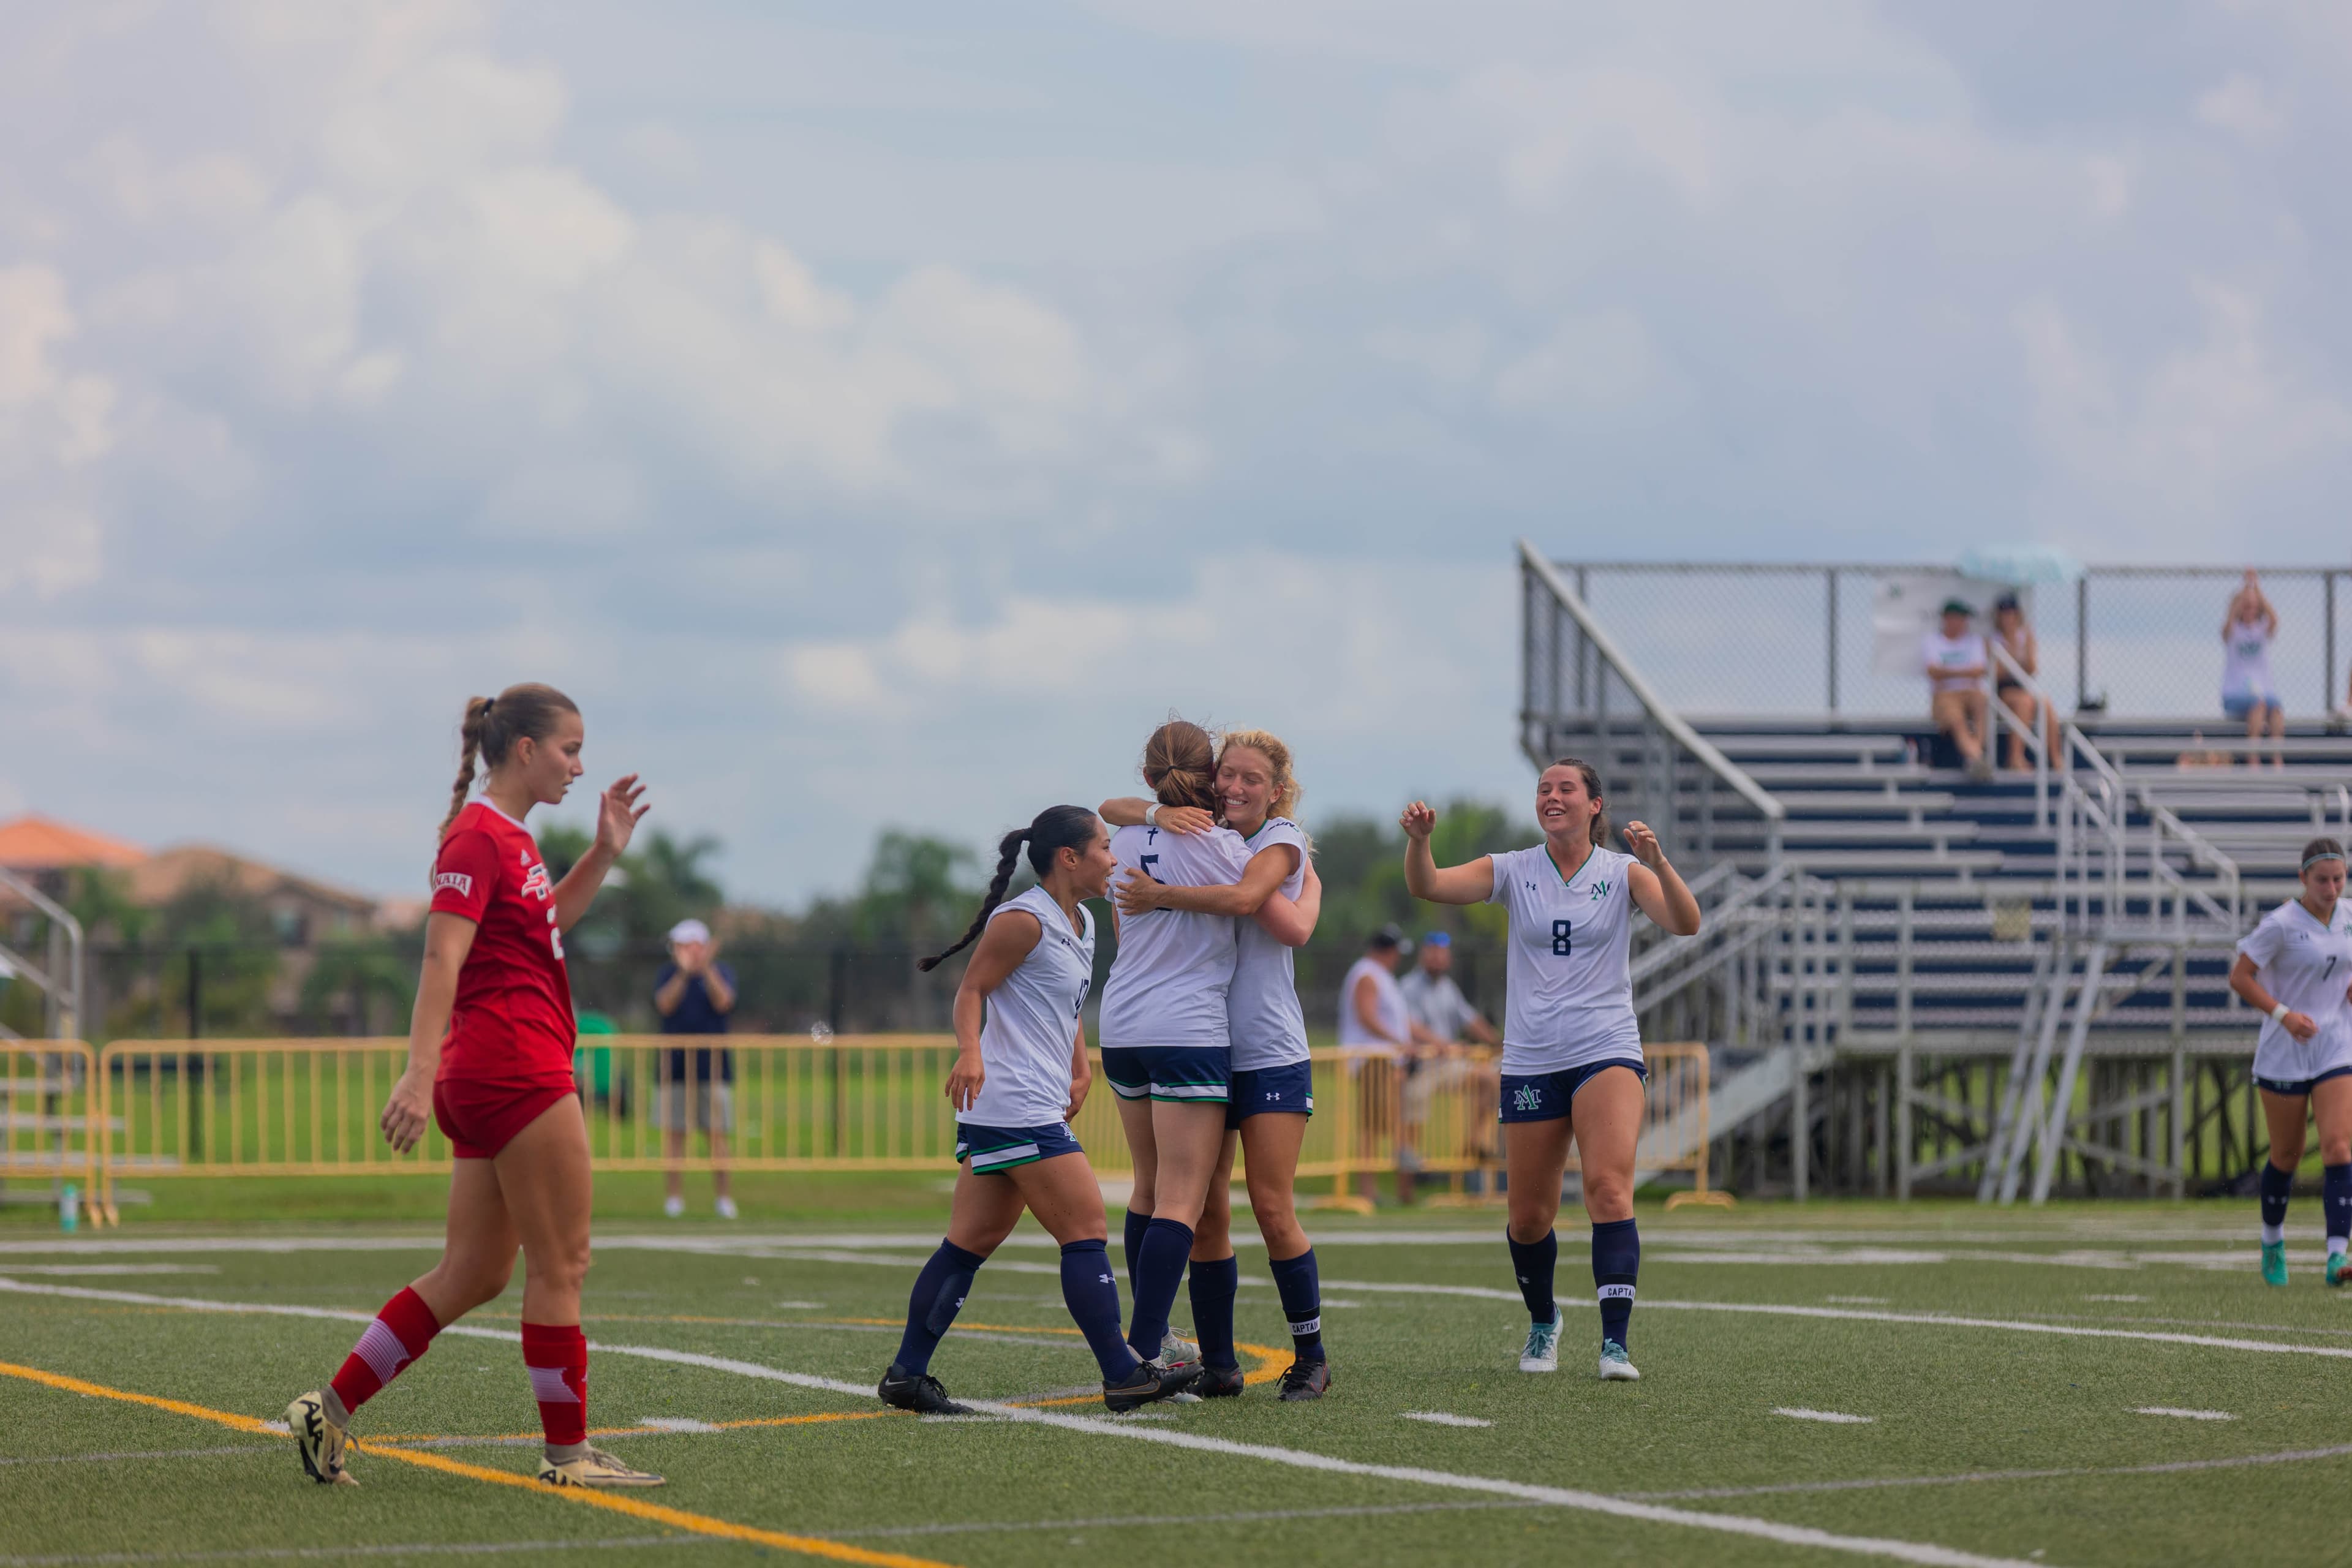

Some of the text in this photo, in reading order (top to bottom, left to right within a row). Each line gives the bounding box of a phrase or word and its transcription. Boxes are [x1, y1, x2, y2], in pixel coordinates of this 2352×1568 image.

[434, 874, 467, 891] NAIA
[1552, 919, 1572, 956] 8
[2323, 955, 2337, 982] 7
